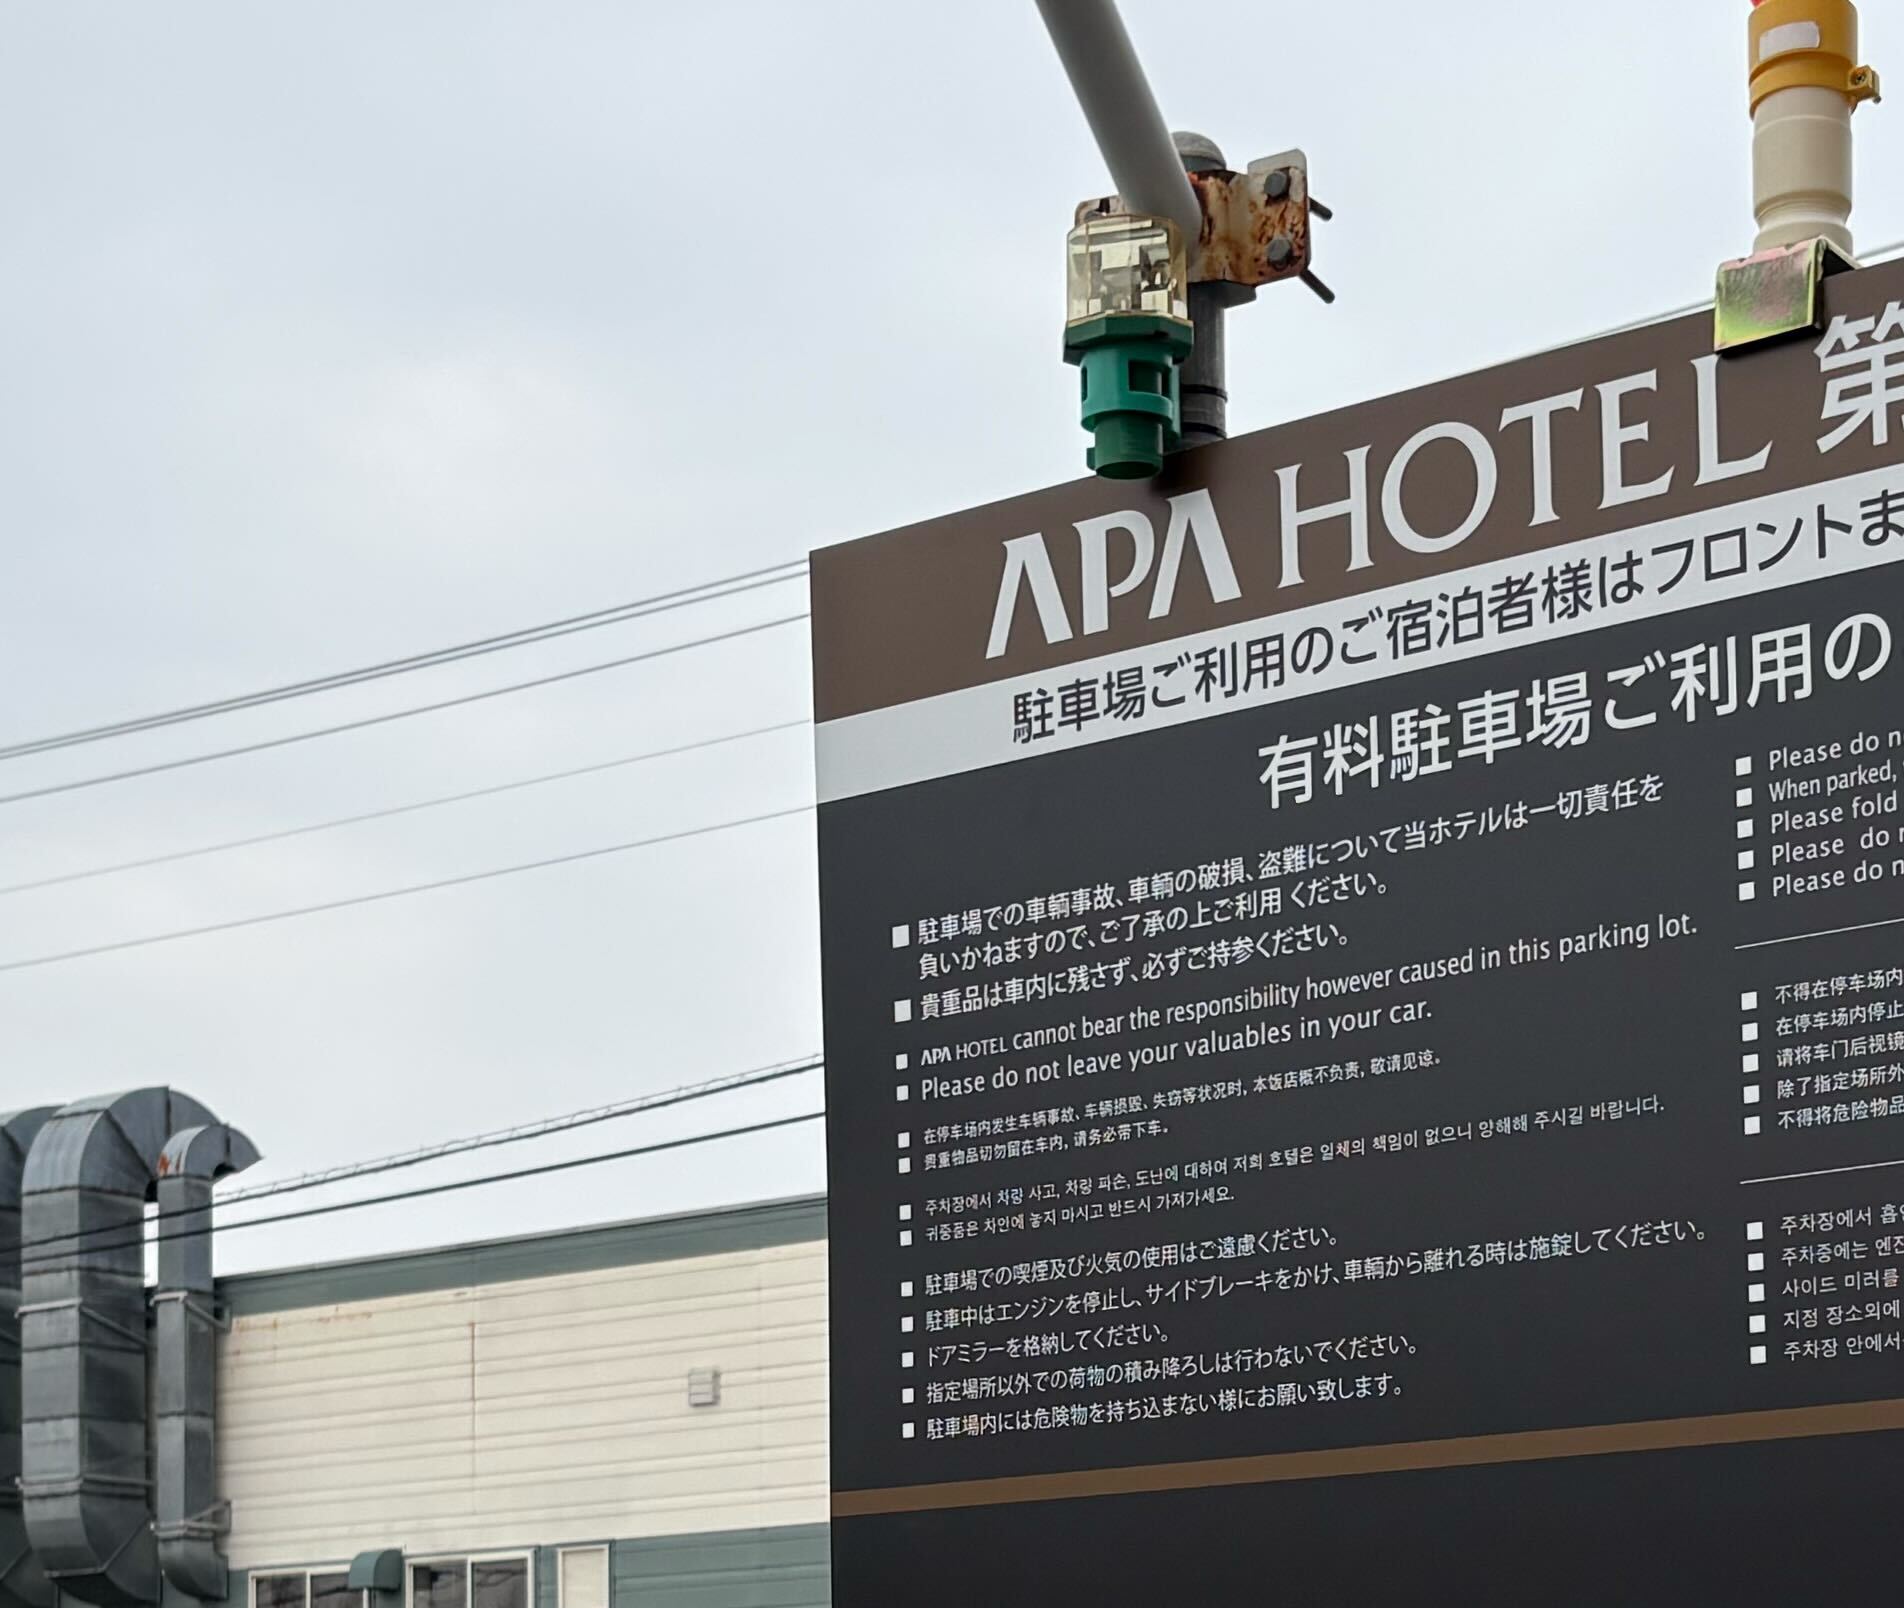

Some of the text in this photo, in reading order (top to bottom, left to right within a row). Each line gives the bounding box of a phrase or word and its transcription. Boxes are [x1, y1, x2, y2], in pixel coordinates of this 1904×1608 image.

[985, 488, 1242, 660] APA
[1273, 353, 1773, 589] HOTEL
[1769, 742, 1842, 771] Please
[1849, 731, 1880, 755] do
[1768, 777, 1821, 803] When
[1826, 758, 1898, 797] parked,
[1770, 806, 1844, 834] Please
[1851, 789, 1898, 820] fold
[1771, 838, 1844, 867] Please
[1859, 825, 1890, 850] do
[1772, 869, 1845, 898] Please
[1853, 859, 1883, 883] do
[920, 913, 1697, 1067] APA HOTEL cannot bear the responsibility however caused in this parking lot.
[921, 1000, 1432, 1101] Please do not leave your valuables in your car.
[1779, 1206, 1872, 1236] 주차장에서
[1780, 1241, 1869, 1267] 주차중에는
[1782, 1276, 1838, 1298] 사이드
[1844, 1267, 1900, 1291] 미러를
[1783, 1307, 1818, 1330] 지정
[1825, 1298, 1900, 1326] 장소외에
[928, 1323, 1169, 1367] ドアミラーを格納してください。
[1783, 1337, 1839, 1362] 주차장
